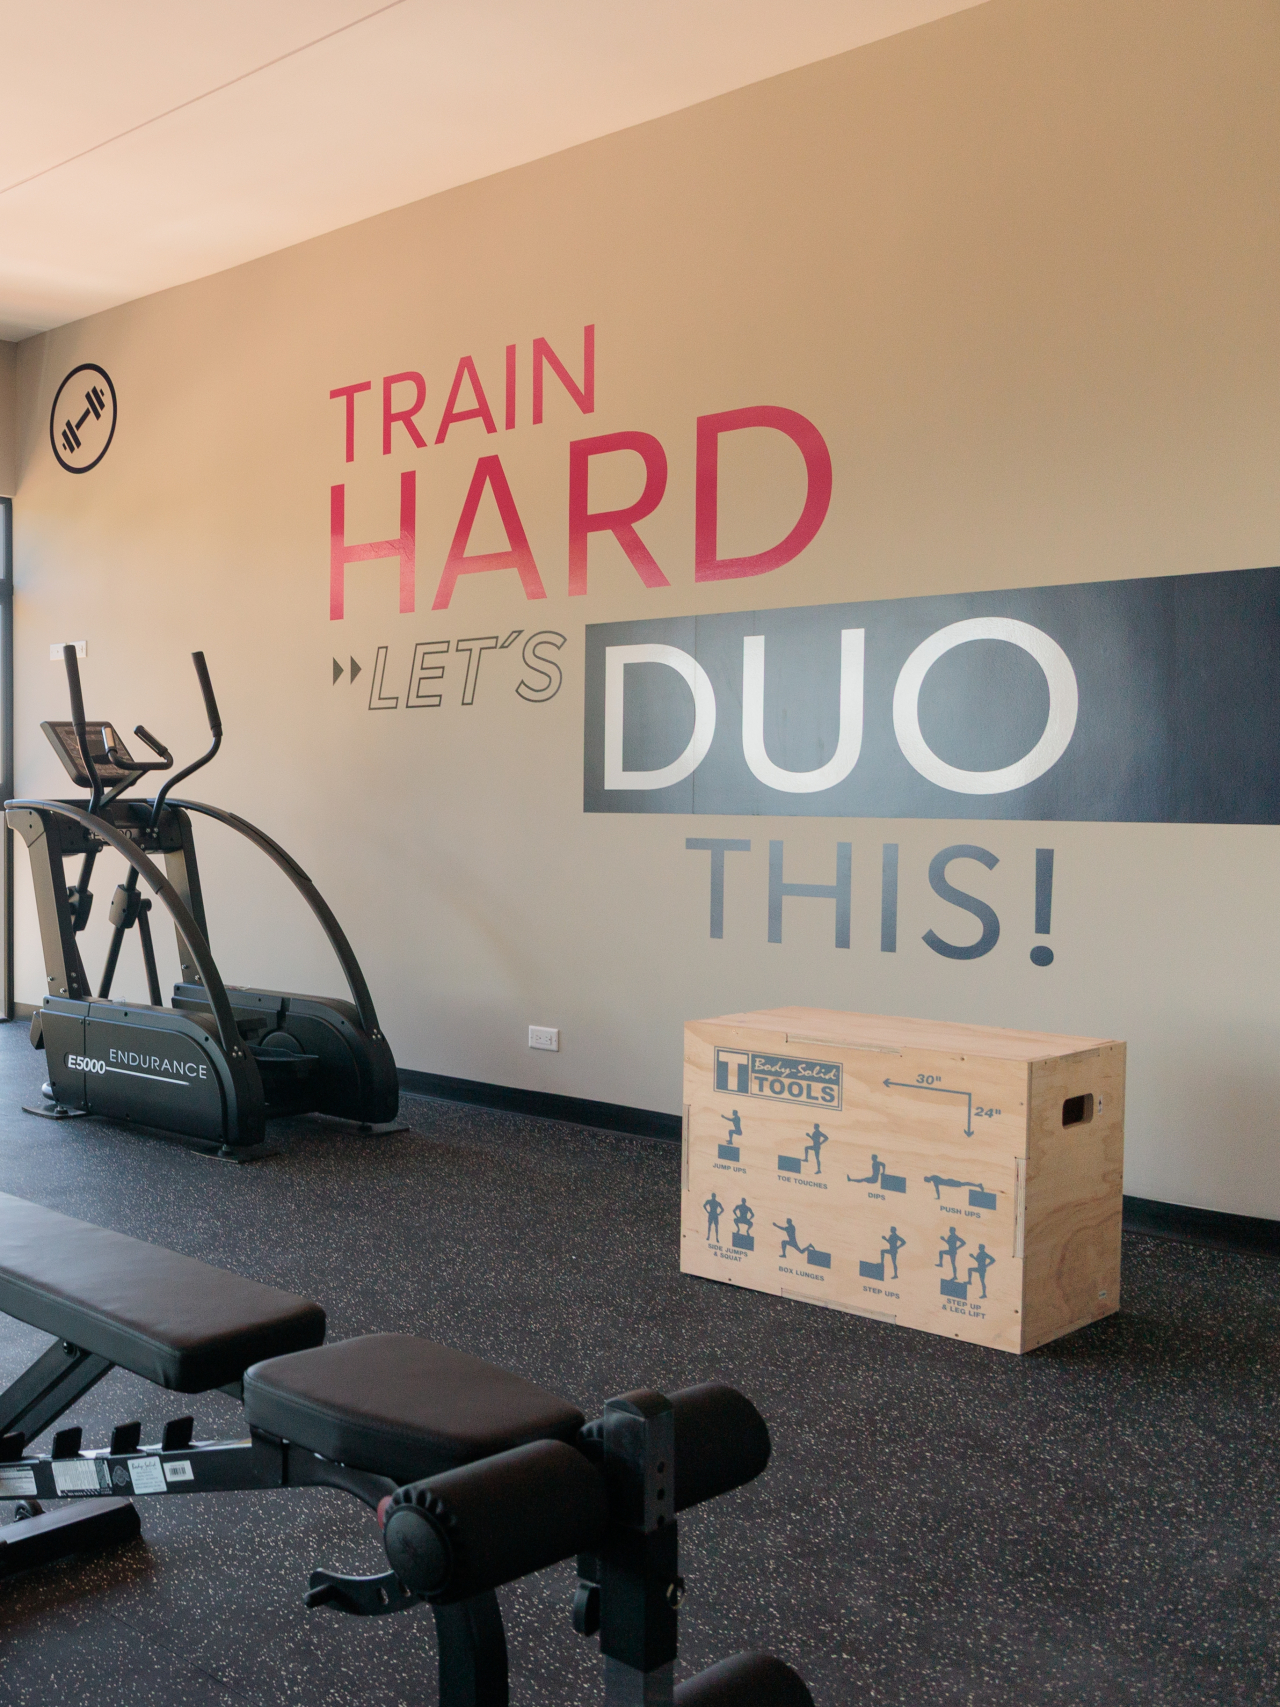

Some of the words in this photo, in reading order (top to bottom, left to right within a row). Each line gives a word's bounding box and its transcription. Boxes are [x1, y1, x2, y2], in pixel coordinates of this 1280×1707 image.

[329, 323, 595, 463] TRAIN
[329, 405, 833, 621] HARD
[603, 616, 1079, 795] DUO
[685, 837, 1055, 968] THIS!
[67, 1054, 106, 1075] E5000
[109, 1048, 207, 1079] ENDURANCE
[754, 1057, 837, 1081] Body-Solid
[915, 1073, 942, 1085] 30"
[754, 1075, 836, 1103] TOOLS
[973, 1106, 1001, 1119] 24"
[712, 1163, 732, 1171] JUMP
[777, 1175, 792, 1183] TOE
[793, 1178, 828, 1190] TOUCHES
[867, 1192, 886, 1201] DIPS
[940, 1205, 962, 1215] PUSH
[964, 1210, 981, 1219] UPS
[708, 1243, 723, 1252] SIDE
[725, 1247, 748, 1257] JUMPS
[720, 1252, 742, 1262] SQUAT
[778, 1265, 794, 1275] BOX
[795, 1269, 825, 1282] LUNGES
[862, 1285, 883, 1295] STEP
[884, 1290, 900, 1300] UPS
[946, 1298, 968, 1308] STEP
[970, 1303, 982, 1311] UP
[949, 1305, 966, 1315] LEG
[968, 1309, 986, 1320] LIFT
